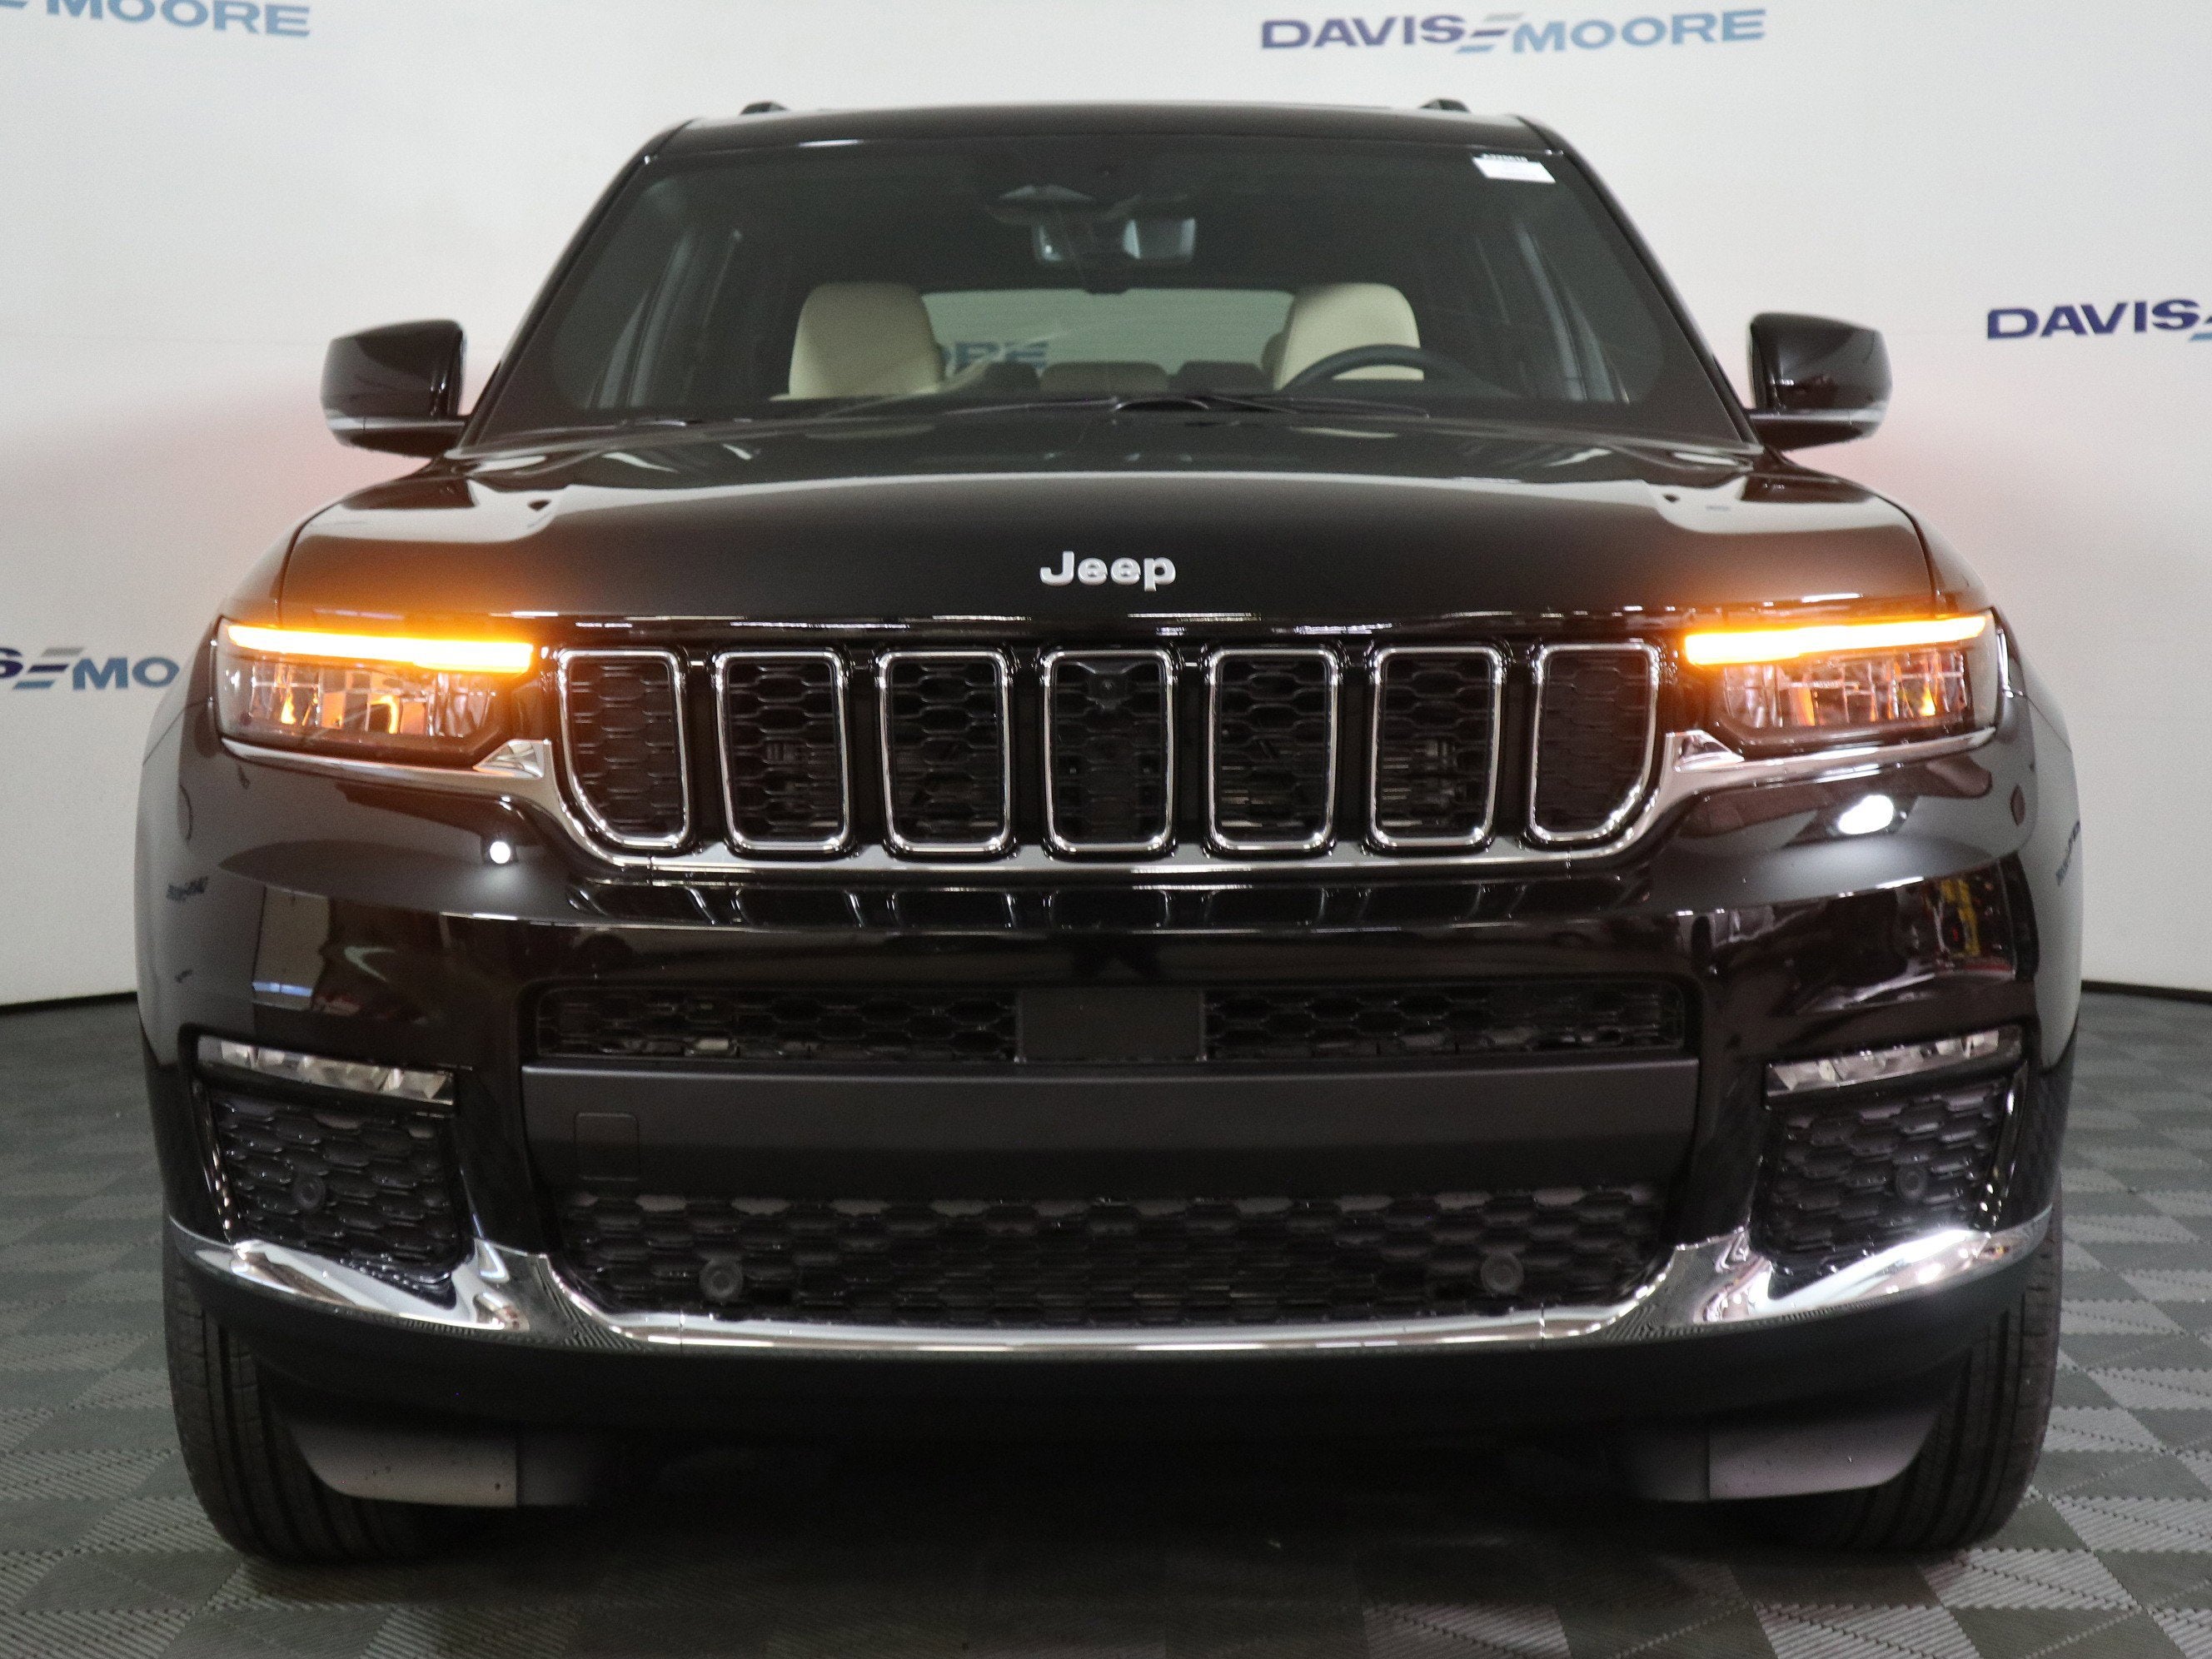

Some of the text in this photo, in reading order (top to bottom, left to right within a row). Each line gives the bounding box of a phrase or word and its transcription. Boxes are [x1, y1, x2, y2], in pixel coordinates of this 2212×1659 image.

[1261, 9, 1766, 53] DAVIS MOORE
[1986, 298, 2201, 341] DAVIS
[1039, 551, 1177, 592] Jeep
